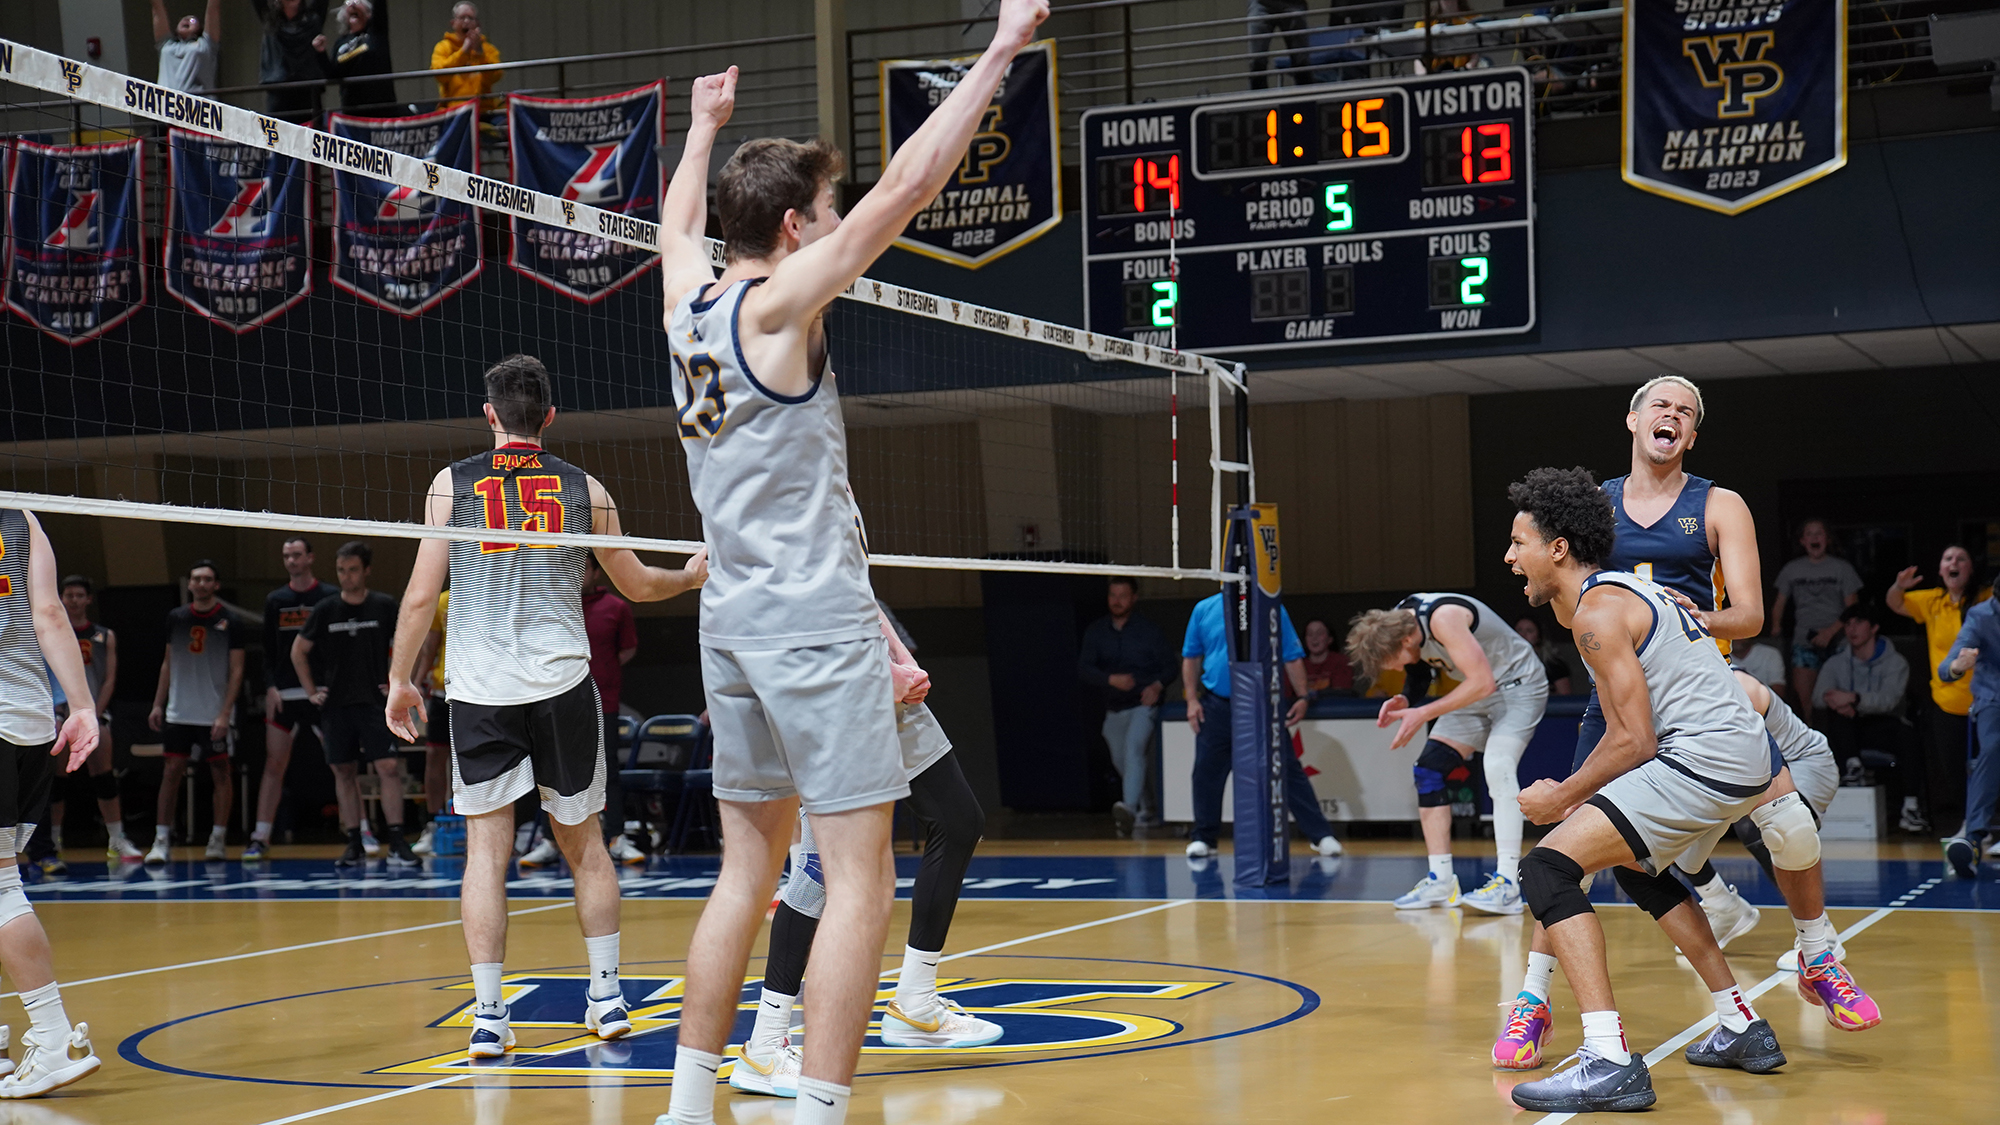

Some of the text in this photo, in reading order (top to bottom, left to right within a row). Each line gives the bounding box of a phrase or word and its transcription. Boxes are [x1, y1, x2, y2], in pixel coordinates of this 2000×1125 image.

[1683, 4, 1784, 31] SPORTS
[1682, 30, 1784, 119] WP
[1414, 81, 1522, 117] VISITOR
[535, 119, 634, 143] BASKETBALL
[550, 107, 623, 127] WOMEN'S
[1102, 115, 1175, 147] HOME
[371, 125, 440, 146] WOMEN'S
[1664, 120, 1804, 150] NATIONAL
[1461, 123, 1512, 184] 13
[1661, 141, 1806, 171] CHAMPION
[1133, 154, 1180, 213] 14
[1261, 179, 1298, 198] POSS
[1705, 170, 1760, 190] 2023
[59, 59, 82, 93] WP
[125, 79, 223, 132] STATESMEN
[258, 117, 280, 147] WP
[312, 133, 394, 178] STATESMEN
[422, 162, 440, 190] WP
[467, 175, 536, 214] STATESMEN
[561, 200, 576, 226] WP
[599, 212, 659, 246] STATESMEN
[897, 289, 939, 315] STATESMEN
[973, 308, 1010, 331] STATESMEN
[1325, 183, 1353, 231] 5
[1408, 194, 1475, 220] BONUS
[915, 202, 1031, 231] CHAMPION
[1245, 197, 1315, 222] PERIOD
[952, 228, 996, 247] 2022
[1134, 218, 1196, 243] BONUS
[1428, 231, 1491, 256] FOULS
[1122, 257, 1181, 280] FOULS
[1236, 240, 1384, 272] PLAYER FOULS
[1461, 257, 1488, 304] 2
[1152, 281, 1178, 327] 2
[1284, 319, 1335, 340] GAME
[1440, 309, 1482, 330] WON
[473, 475, 565, 554] 15
[1678, 517, 1698, 534] WP
[1269, 607, 1284, 863] STATESMEN
